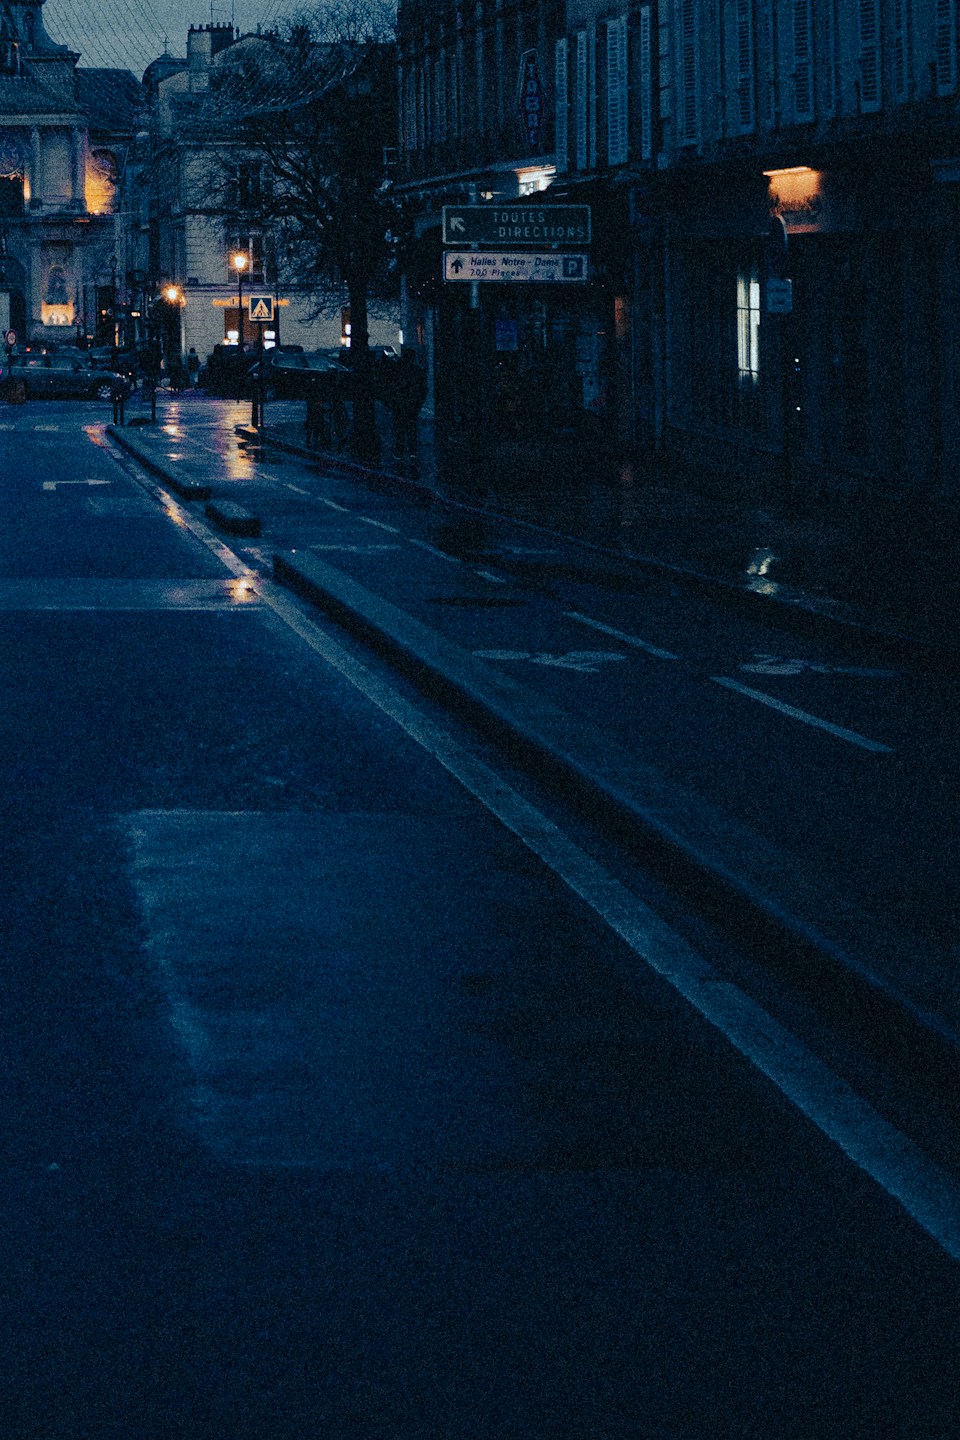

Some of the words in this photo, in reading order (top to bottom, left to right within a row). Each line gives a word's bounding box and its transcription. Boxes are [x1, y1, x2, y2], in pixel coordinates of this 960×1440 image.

[525, 63, 539, 145] TABAC
[493, 212, 545, 223] TOUTES
[471, 258, 497, 266] Halles
[568, 261, 577, 274] P
